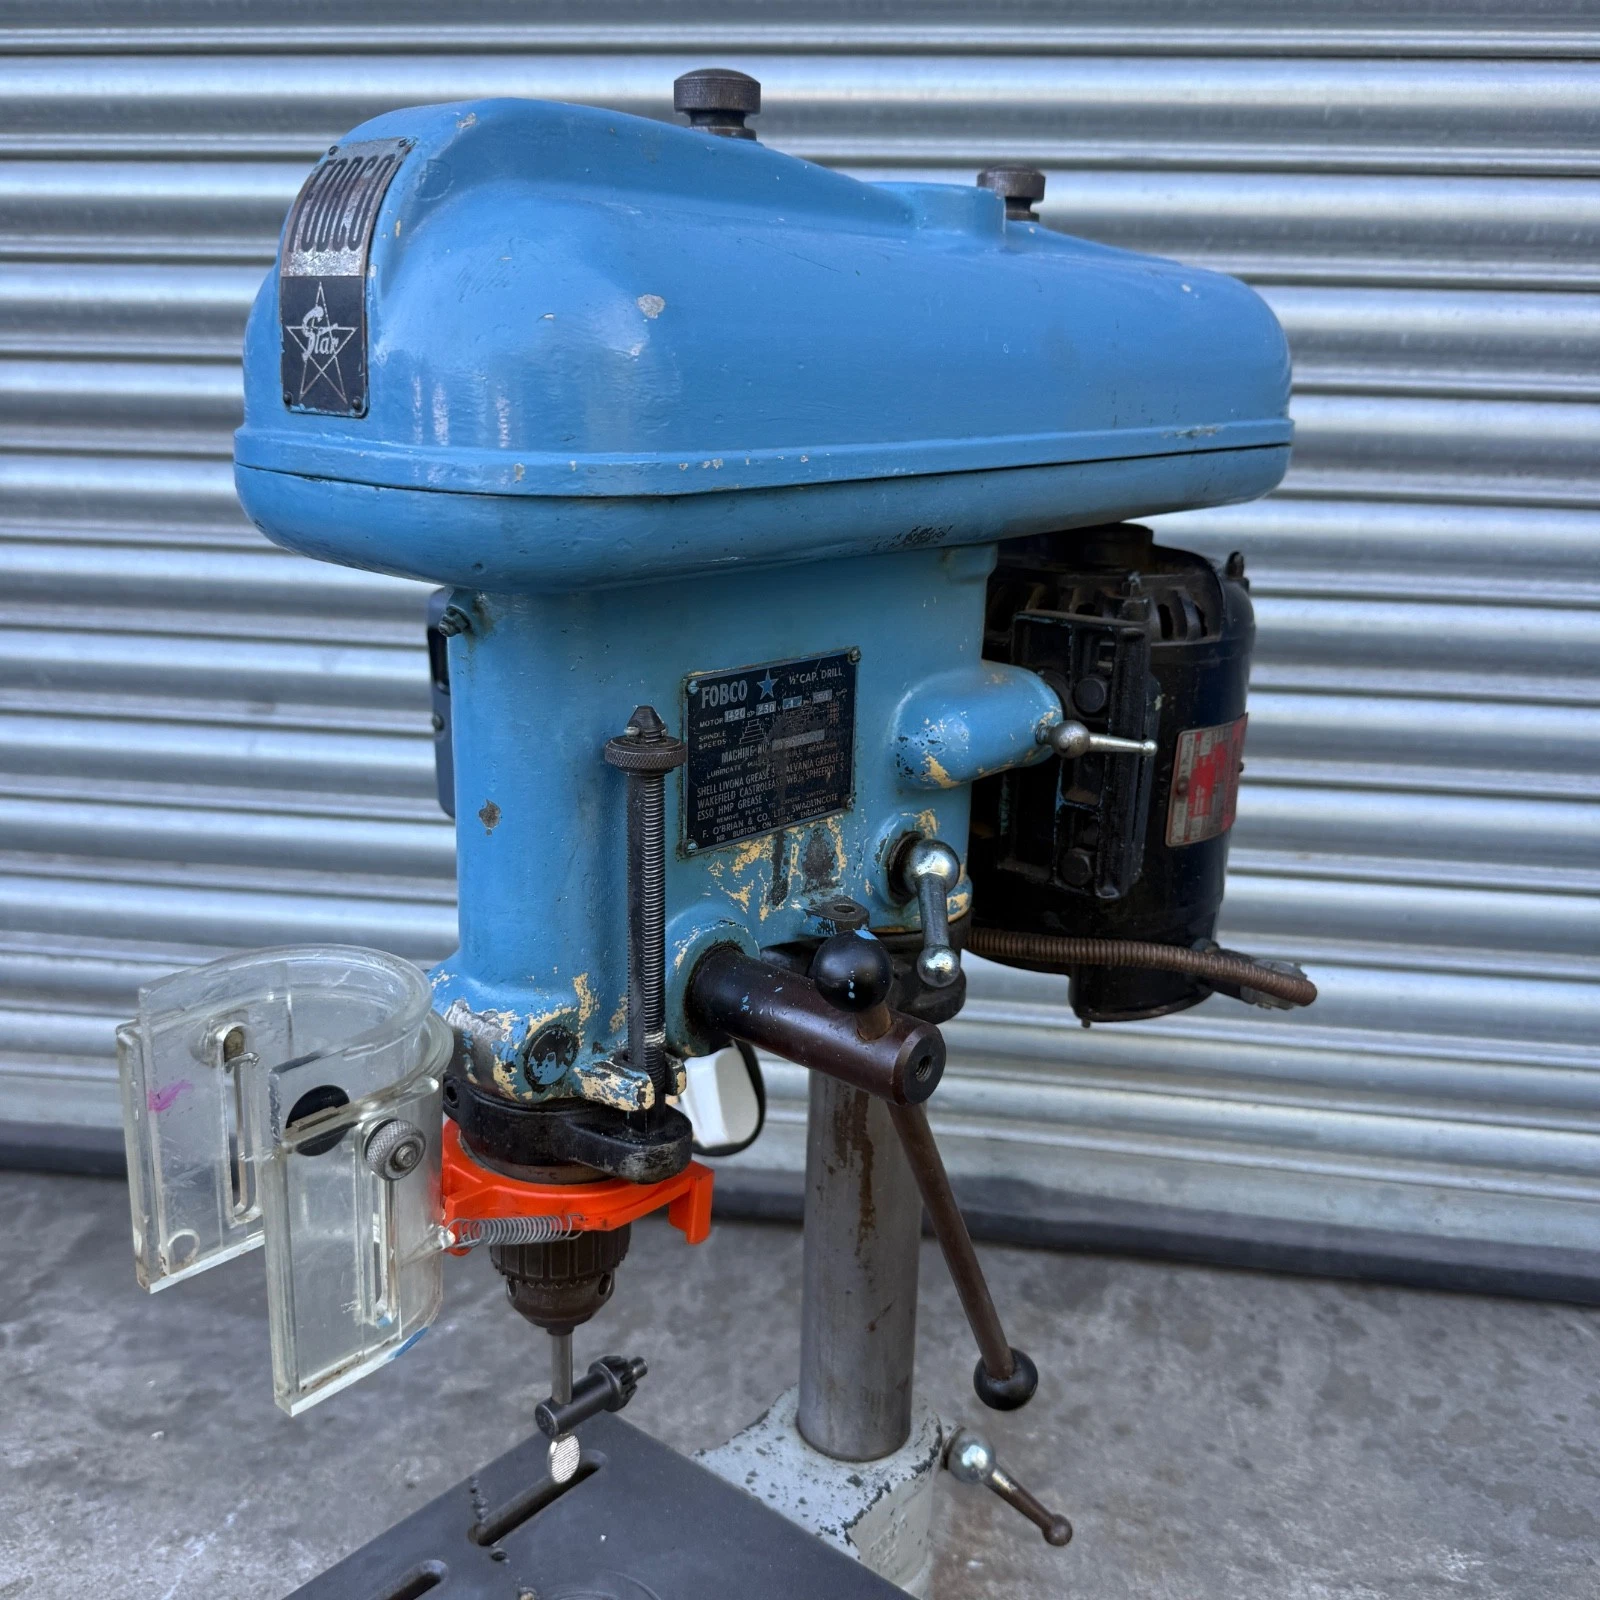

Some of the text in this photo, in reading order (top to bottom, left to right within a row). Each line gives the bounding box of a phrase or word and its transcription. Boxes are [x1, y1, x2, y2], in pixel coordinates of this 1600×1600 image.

[288, 152, 397, 253] FOBCO
[301, 305, 340, 362] Star
[701, 679, 748, 709] FOBCO
[699, 717, 724, 728] MOTOR
[757, 702, 775, 715] 230
[698, 730, 727, 743] SPINDLE
[698, 739, 727, 751] SPEEDS
[696, 783, 718, 798] SHELL
[815, 752, 839, 768] GREASE
[697, 790, 737, 809] WAKEFIELD
[697, 794, 763, 821] ESSO HMP GREASE
[702, 829, 709, 838] F.
[712, 819, 745, 835] O'BRIAN
[747, 816, 754, 826] &
